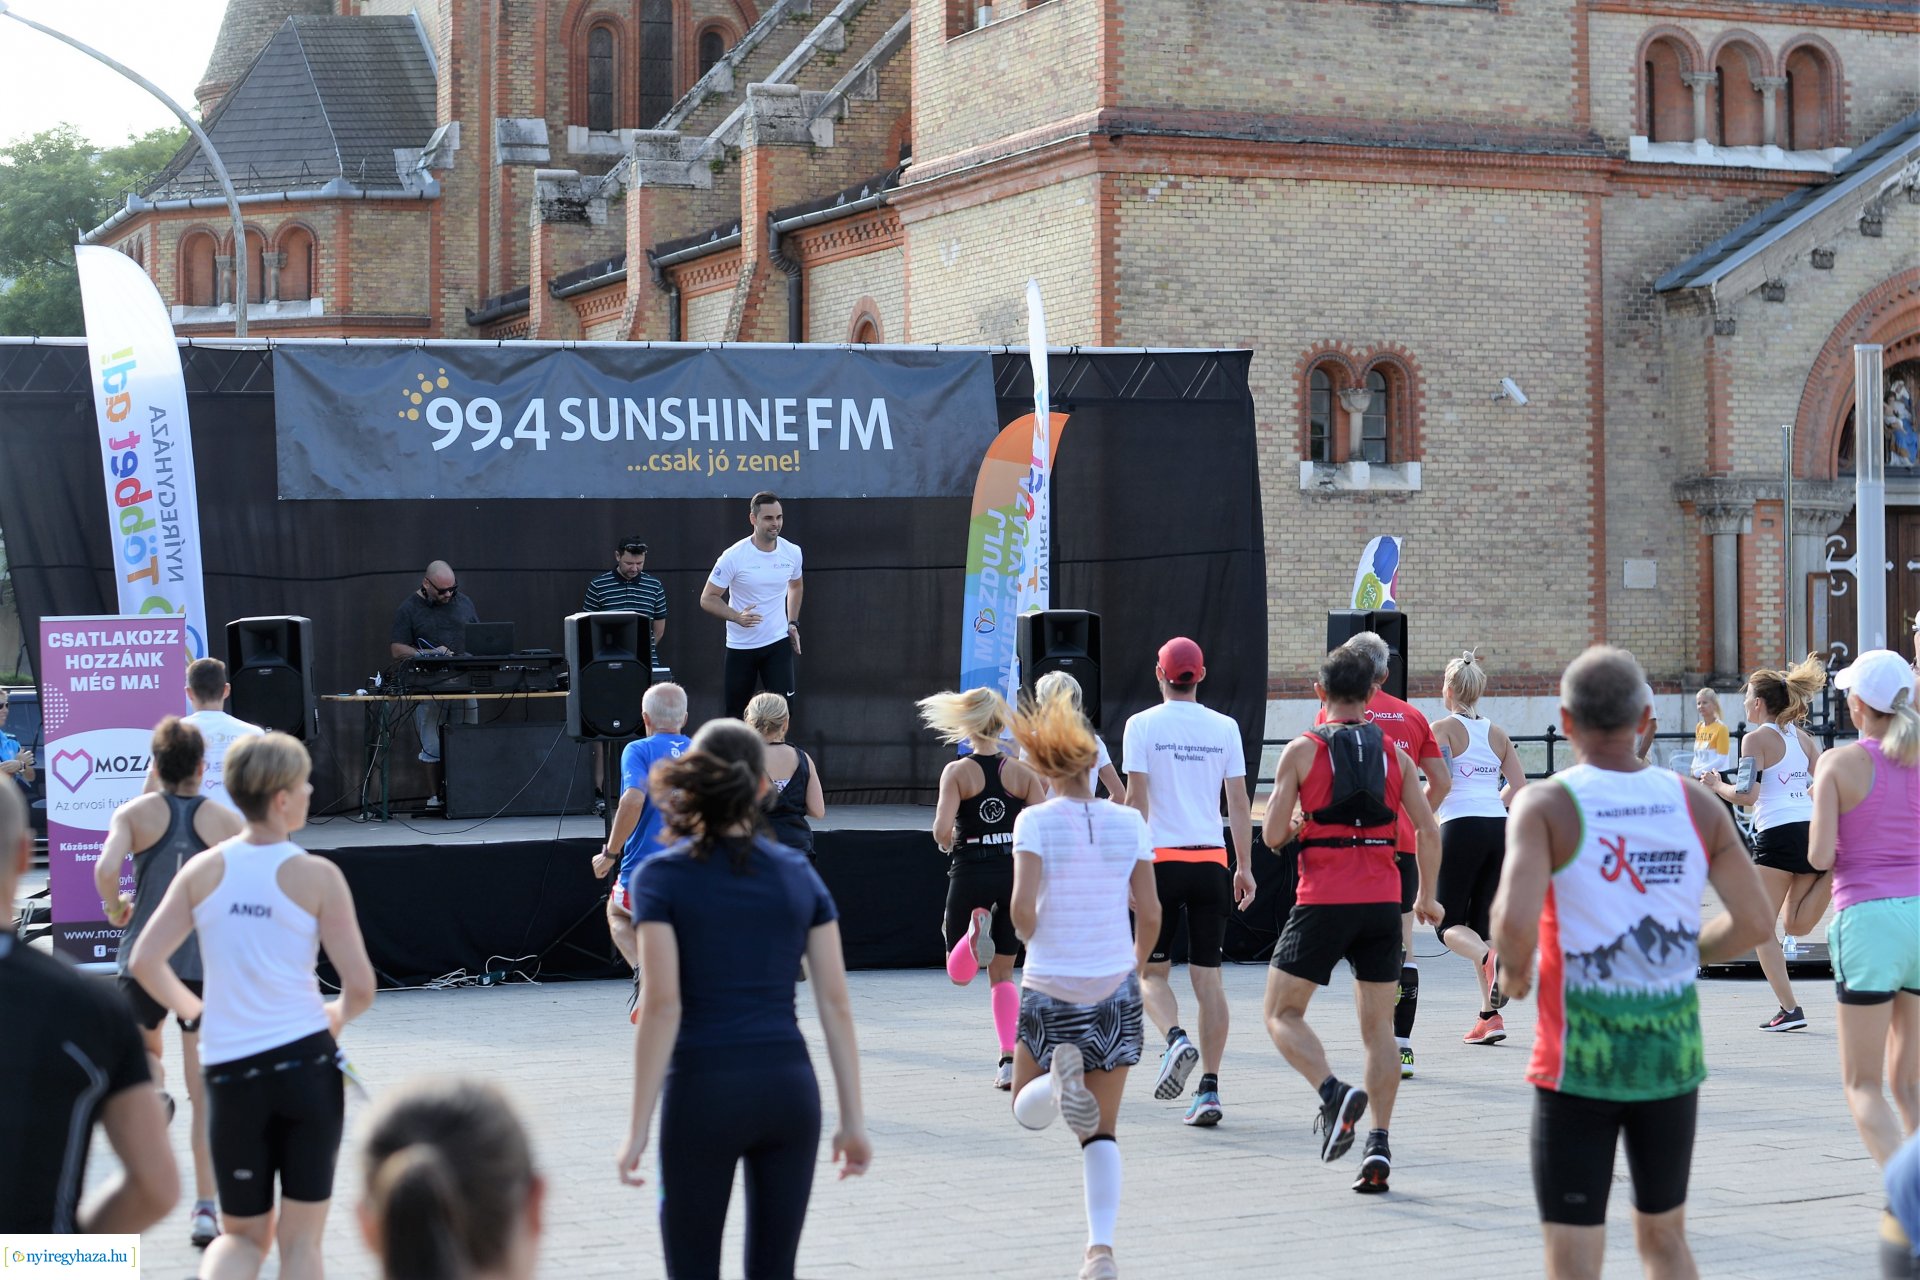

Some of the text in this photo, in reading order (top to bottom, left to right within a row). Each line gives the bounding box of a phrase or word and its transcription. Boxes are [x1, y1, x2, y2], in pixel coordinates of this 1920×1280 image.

[425, 396, 894, 451] 99.4 SUNSHINE FM
[707, 449, 730, 477] jó
[737, 450, 801, 472] zene!
[48, 629, 179, 648] CSATLAKOZZ
[65, 648, 164, 670] HOZZÁNK
[70, 671, 160, 692] MÉG MA!
[55, 801, 70, 811] Az
[72, 798, 106, 810] orvosi
[982, 832, 1014, 844] AND
[229, 902, 272, 918] ANDI
